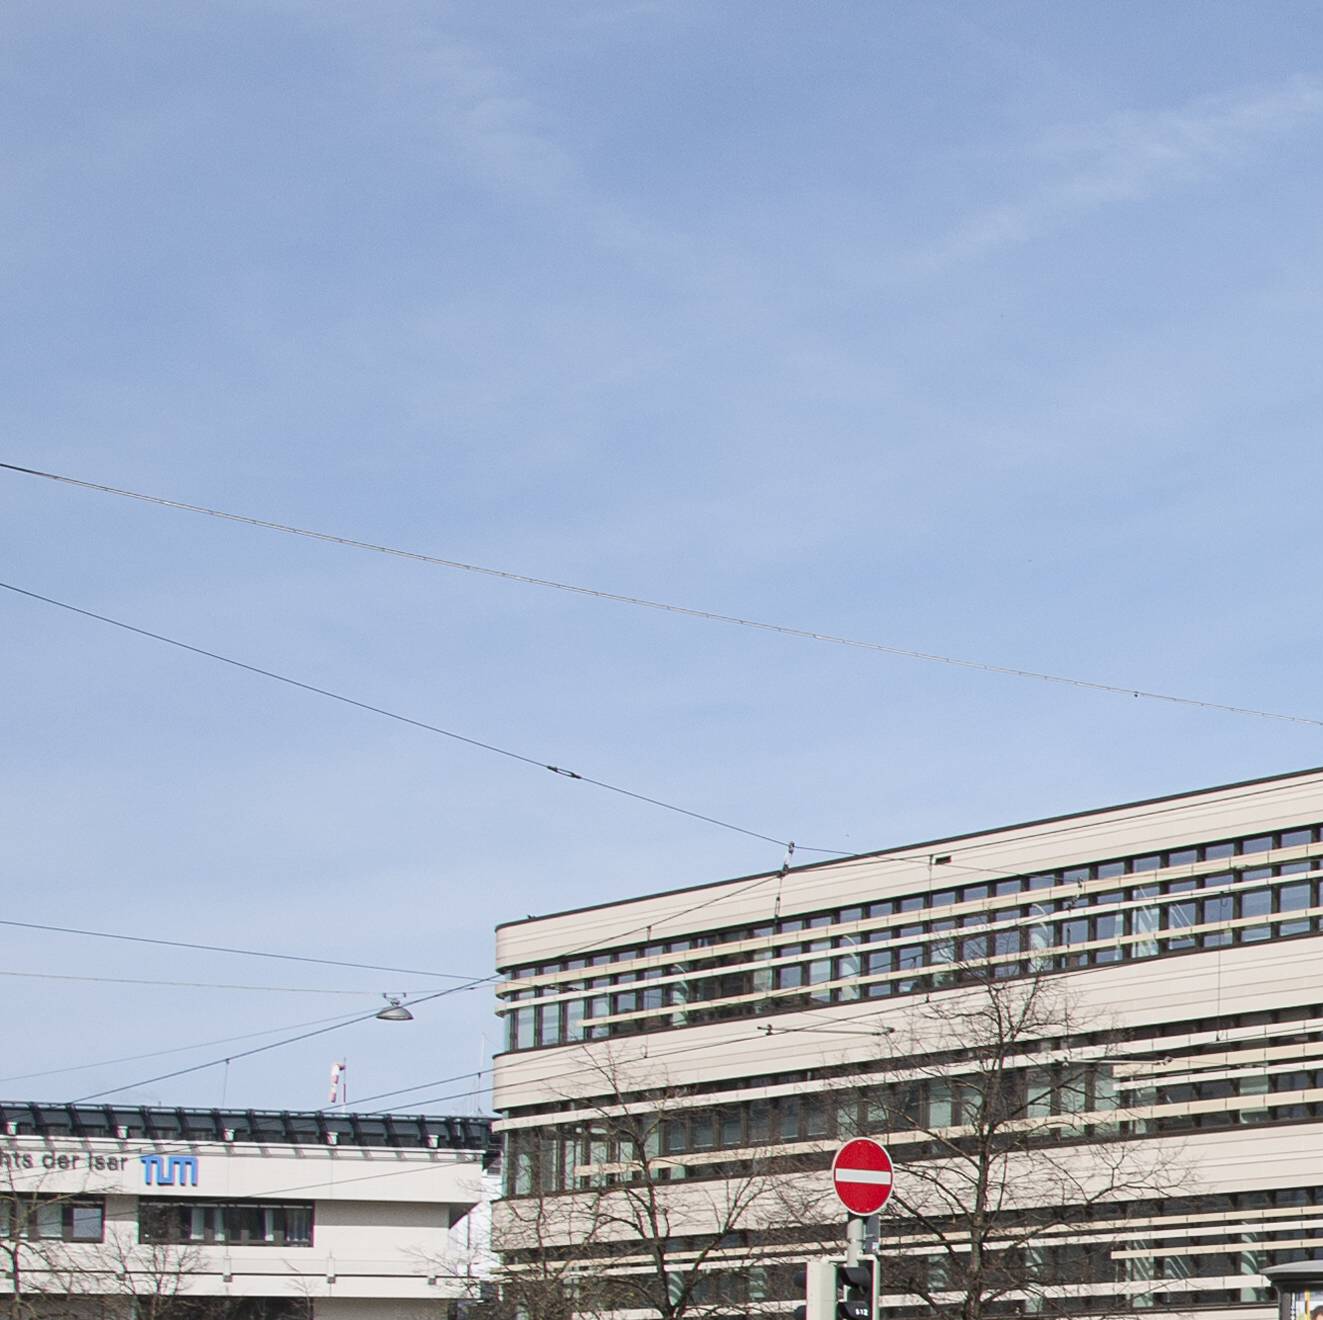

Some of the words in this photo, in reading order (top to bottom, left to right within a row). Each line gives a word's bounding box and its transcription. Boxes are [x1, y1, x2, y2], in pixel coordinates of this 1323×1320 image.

[42, 1150, 80, 1169] der
[89, 1151, 129, 1171] Isar
[141, 1155, 199, 1186] TUM
